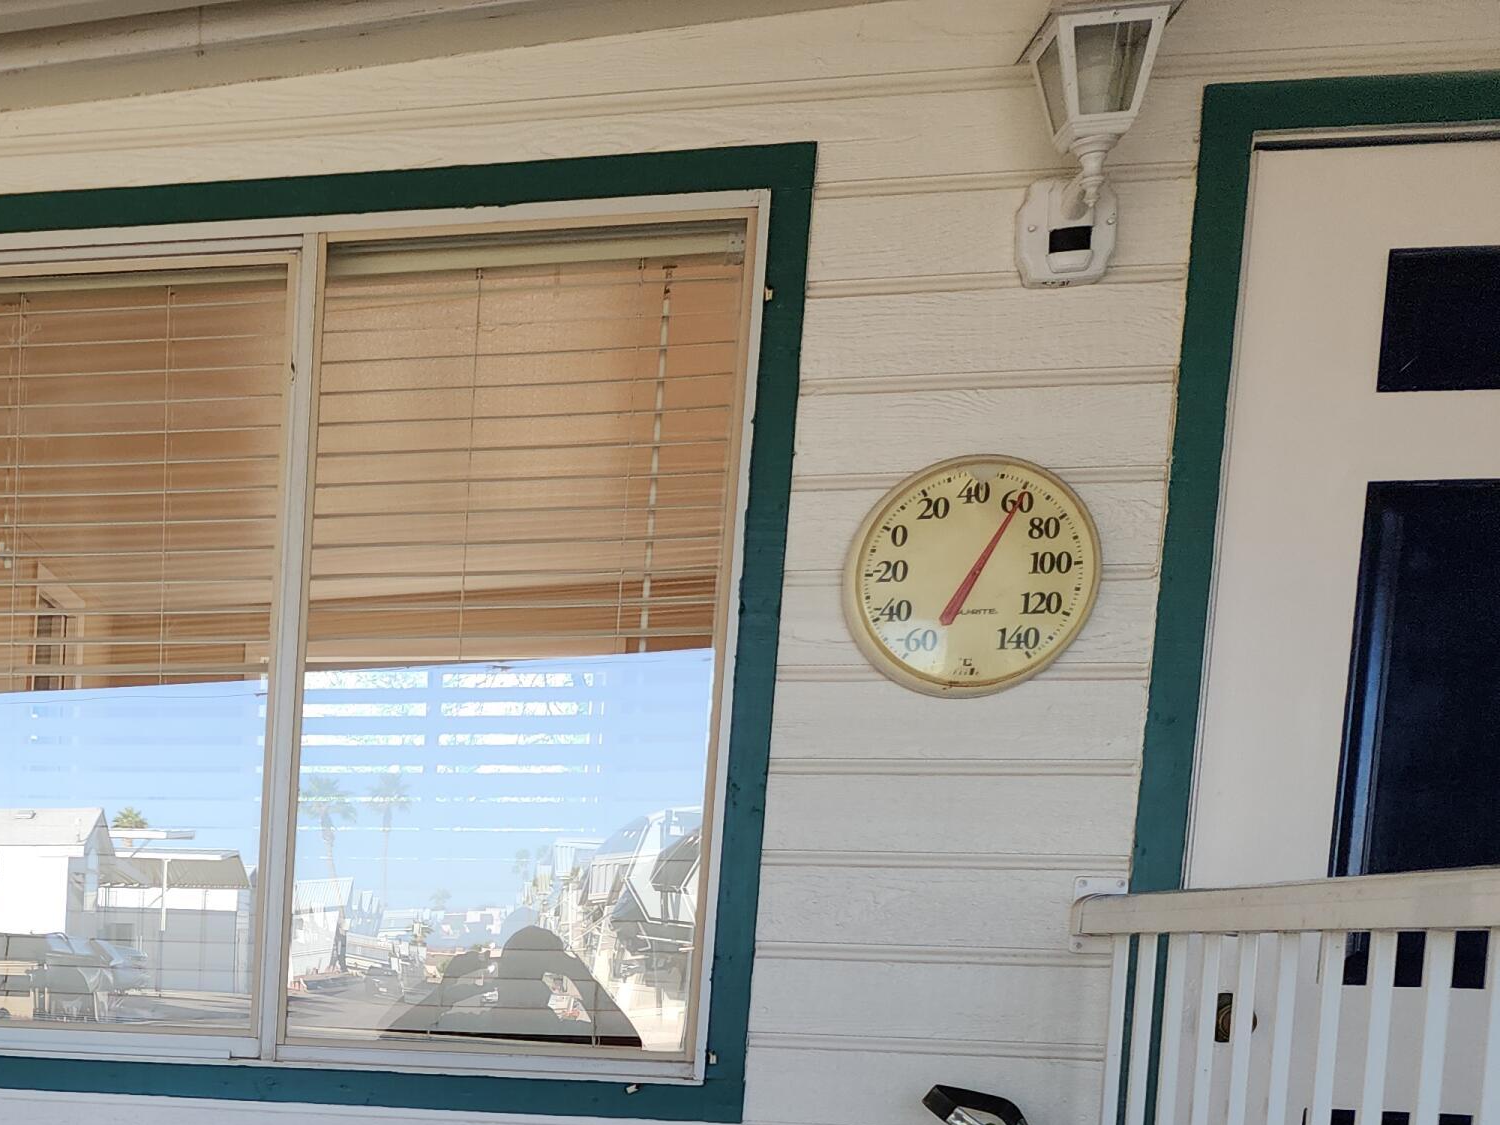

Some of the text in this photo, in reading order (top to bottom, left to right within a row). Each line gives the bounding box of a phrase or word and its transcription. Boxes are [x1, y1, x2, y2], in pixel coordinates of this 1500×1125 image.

[957, 479, 990, 504] 40
[1001, 489, 1034, 514] 60
[916, 497, 950, 520] 20
[890, 524, 908, 548] 0
[1028, 517, 1060, 539] 80
[873, 560, 908, 583] -20
[1028, 551, 1072, 575] 100
[874, 598, 912, 622] -40
[1019, 592, 1062, 615] 120
[896, 628, 938, 652] -60
[997, 625, 1040, 650] 140
